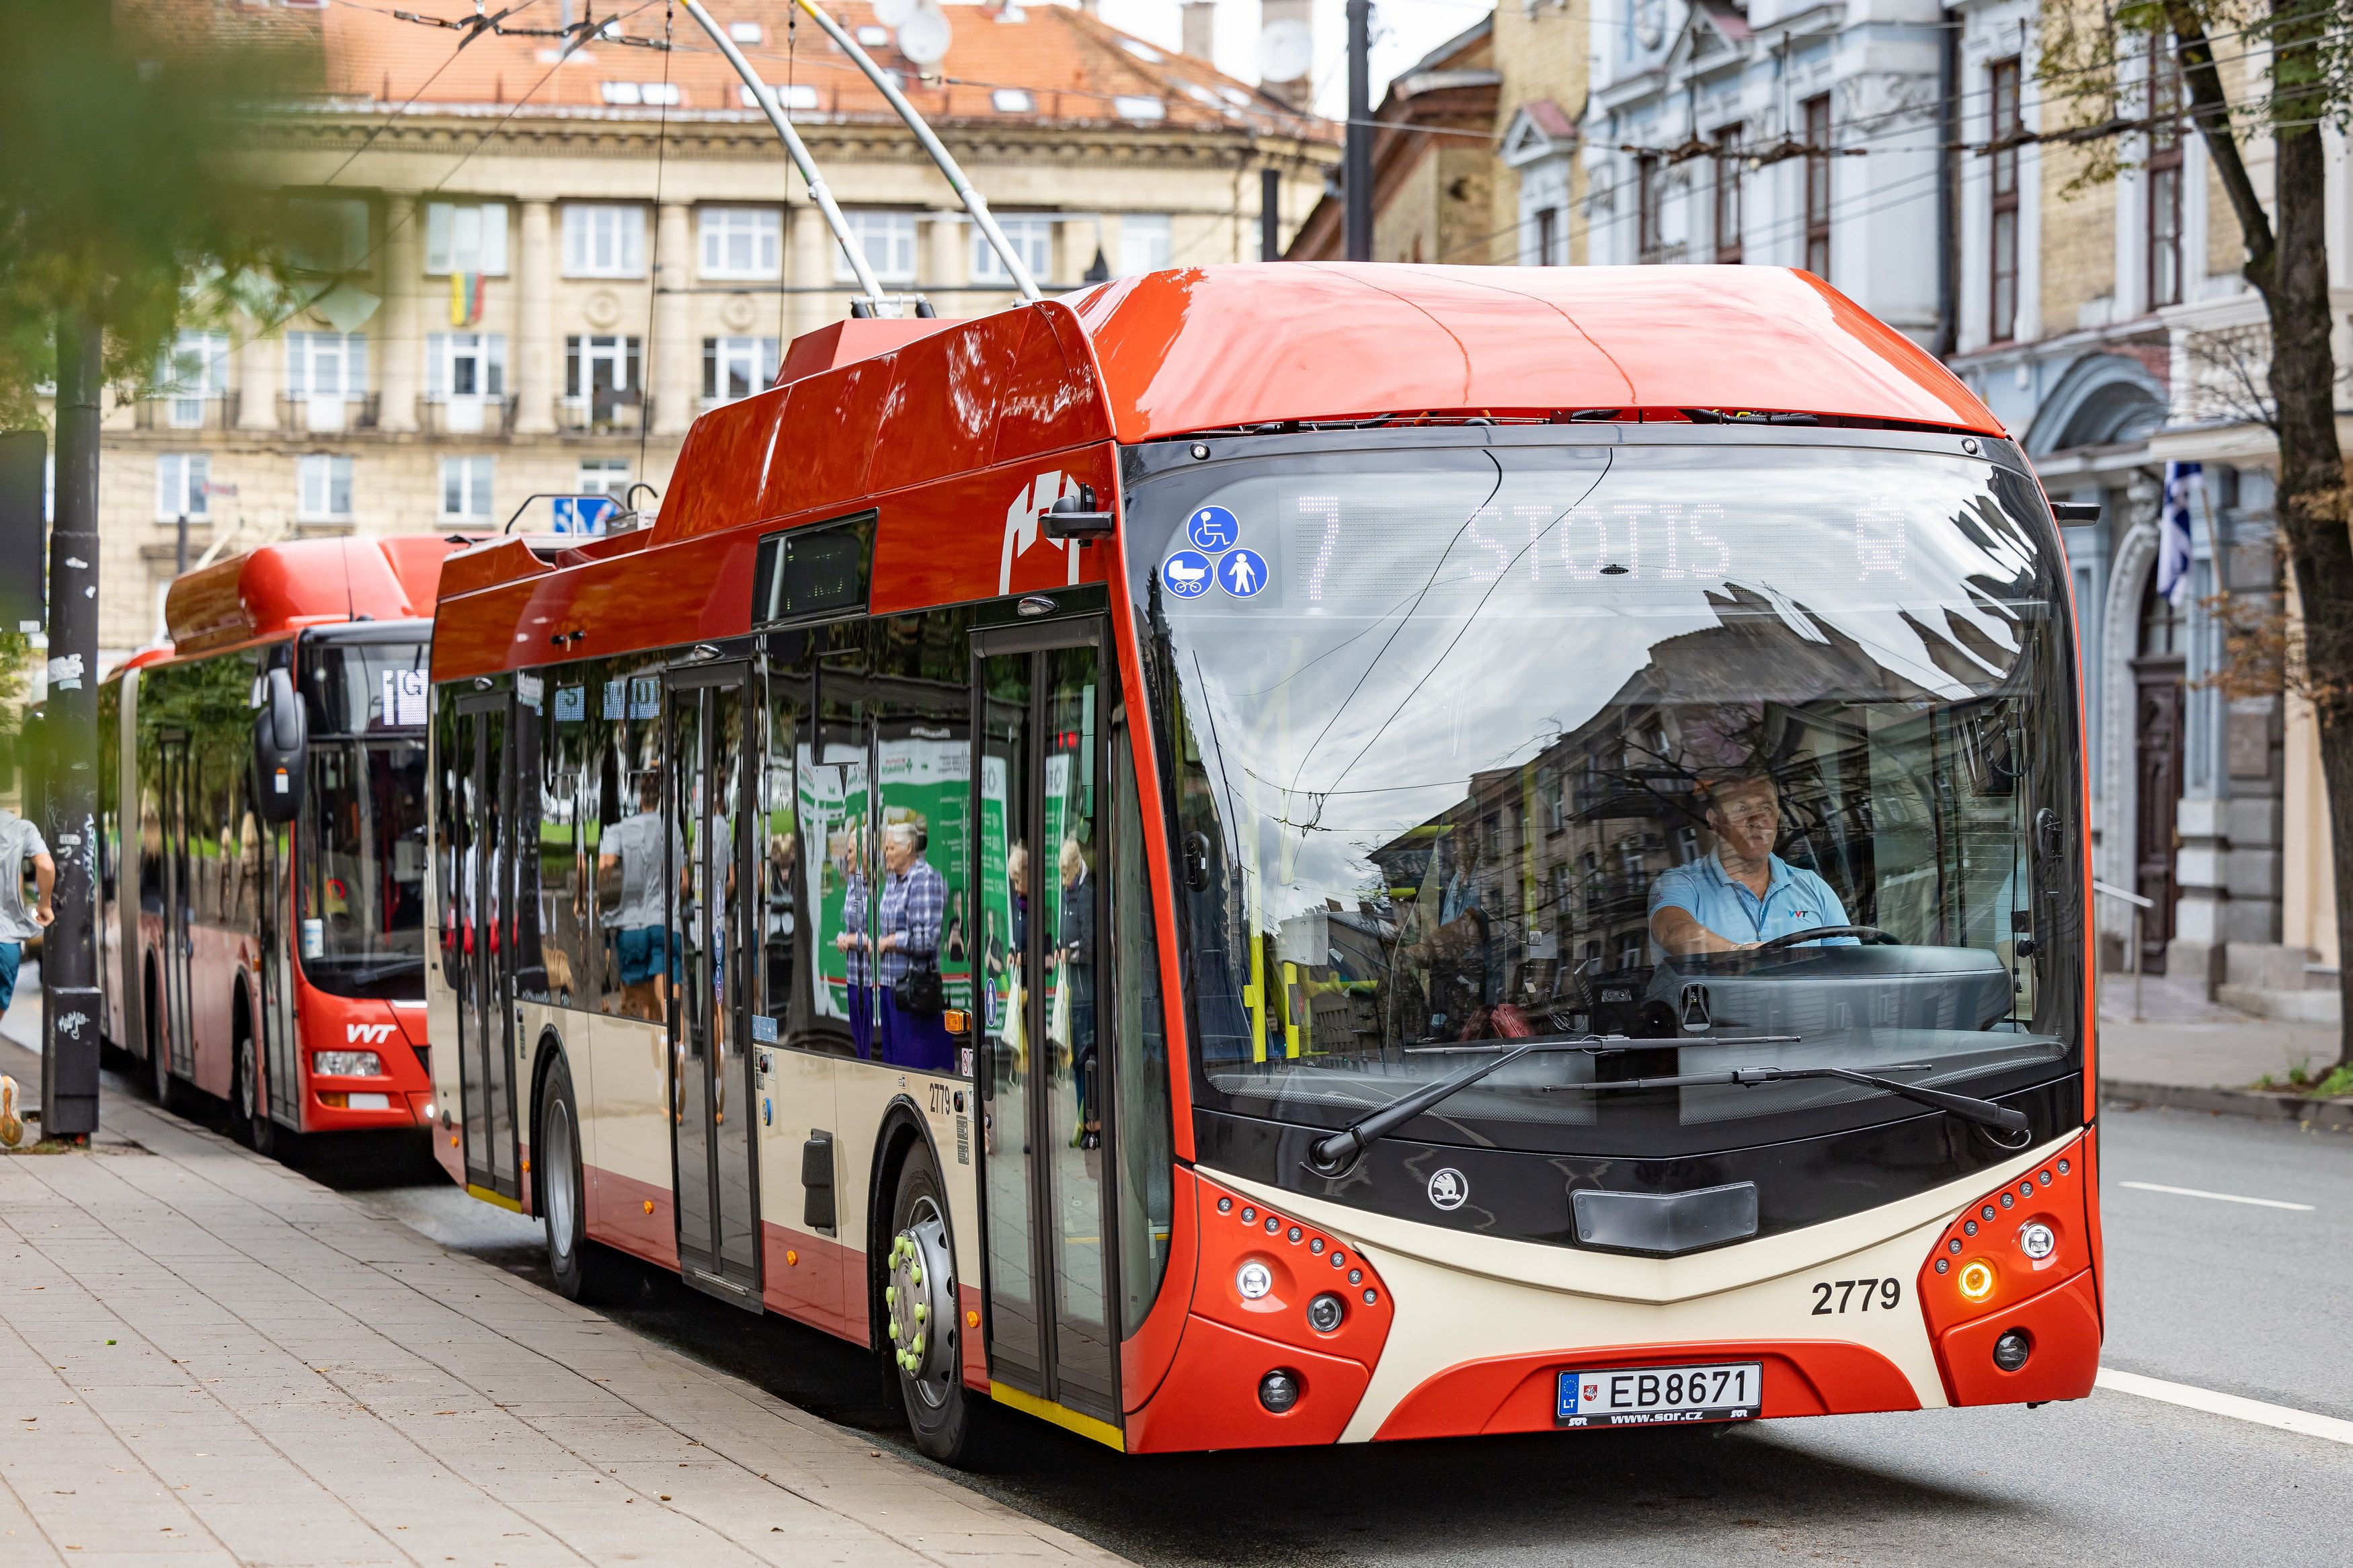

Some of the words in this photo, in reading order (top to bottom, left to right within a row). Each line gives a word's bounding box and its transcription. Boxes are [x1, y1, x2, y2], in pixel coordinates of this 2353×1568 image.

[1299, 496, 1339, 600] 7
[1468, 503, 1730, 581] STOTIS
[346, 1023, 397, 1044] VVT
[929, 1082, 950, 1116] 2779
[1811, 1277, 1901, 1315] 2779
[1563, 1398, 1576, 1409] LT
[1610, 1370, 1745, 1407] EB8671
[1611, 1411, 1703, 1424] www.sor.cz
